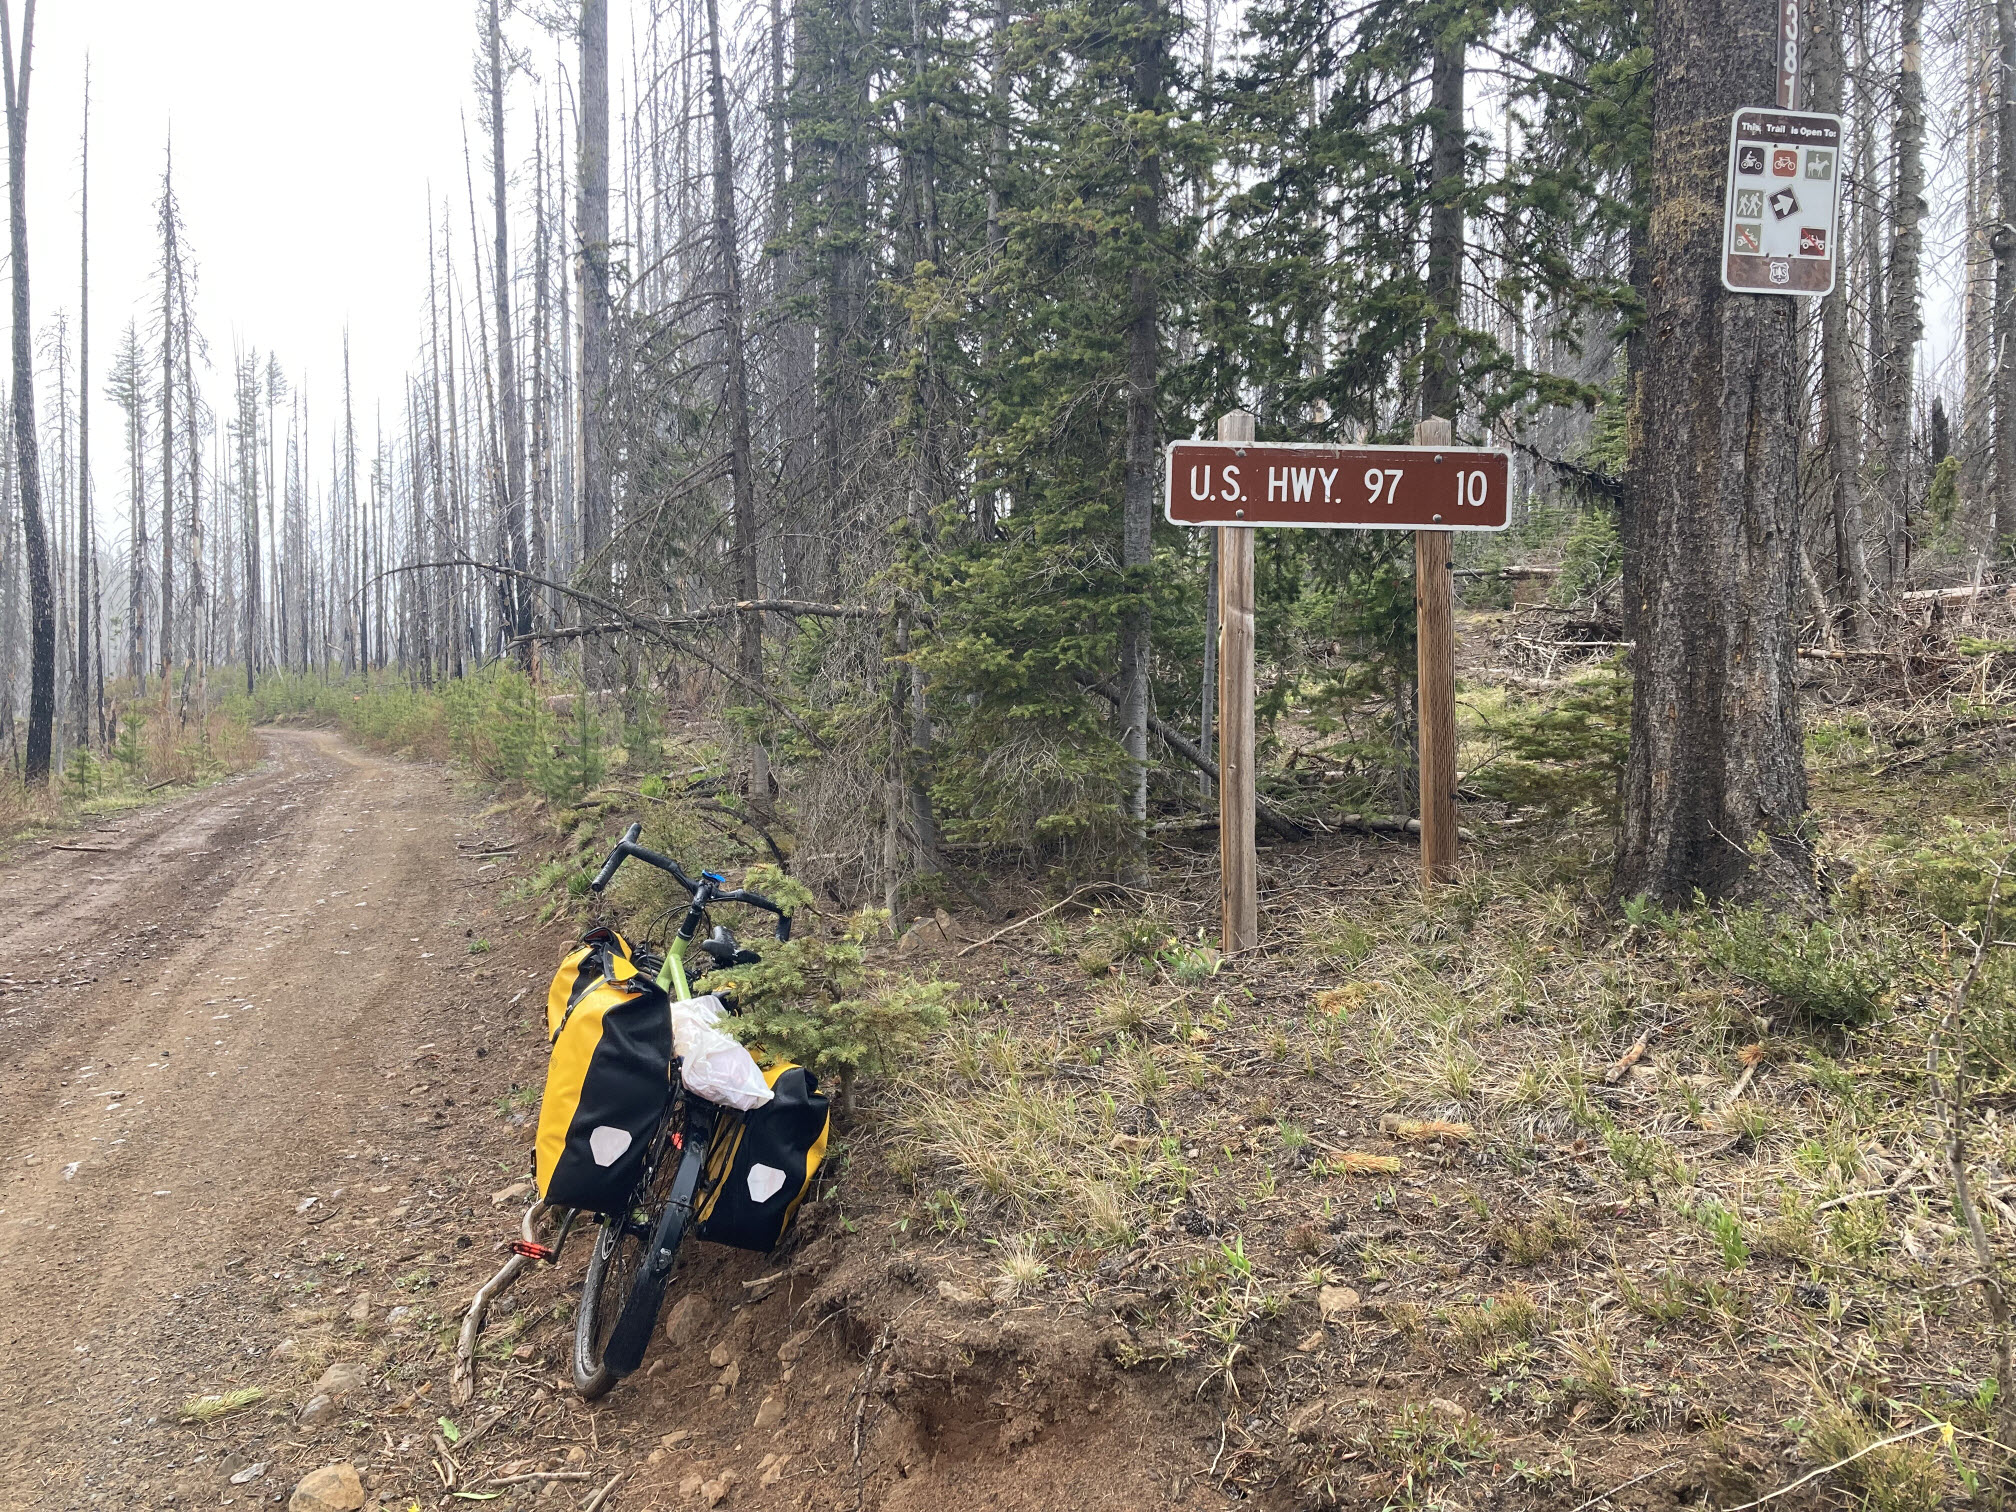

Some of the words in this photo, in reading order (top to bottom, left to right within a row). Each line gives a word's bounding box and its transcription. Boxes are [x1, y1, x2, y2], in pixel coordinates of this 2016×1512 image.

[1784, 0, 1798, 110] 381
[1741, 122, 1761, 131] This
[1766, 124, 1786, 133] Trail
[1791, 126, 1798, 134] is
[1800, 127, 1822, 137] Open
[1824, 129, 1836, 137] To:
[1190, 465, 1248, 502] U.S.
[1268, 466, 1342, 504] HWY.
[1364, 468, 1404, 504] 97
[1456, 470, 1488, 507] 10
